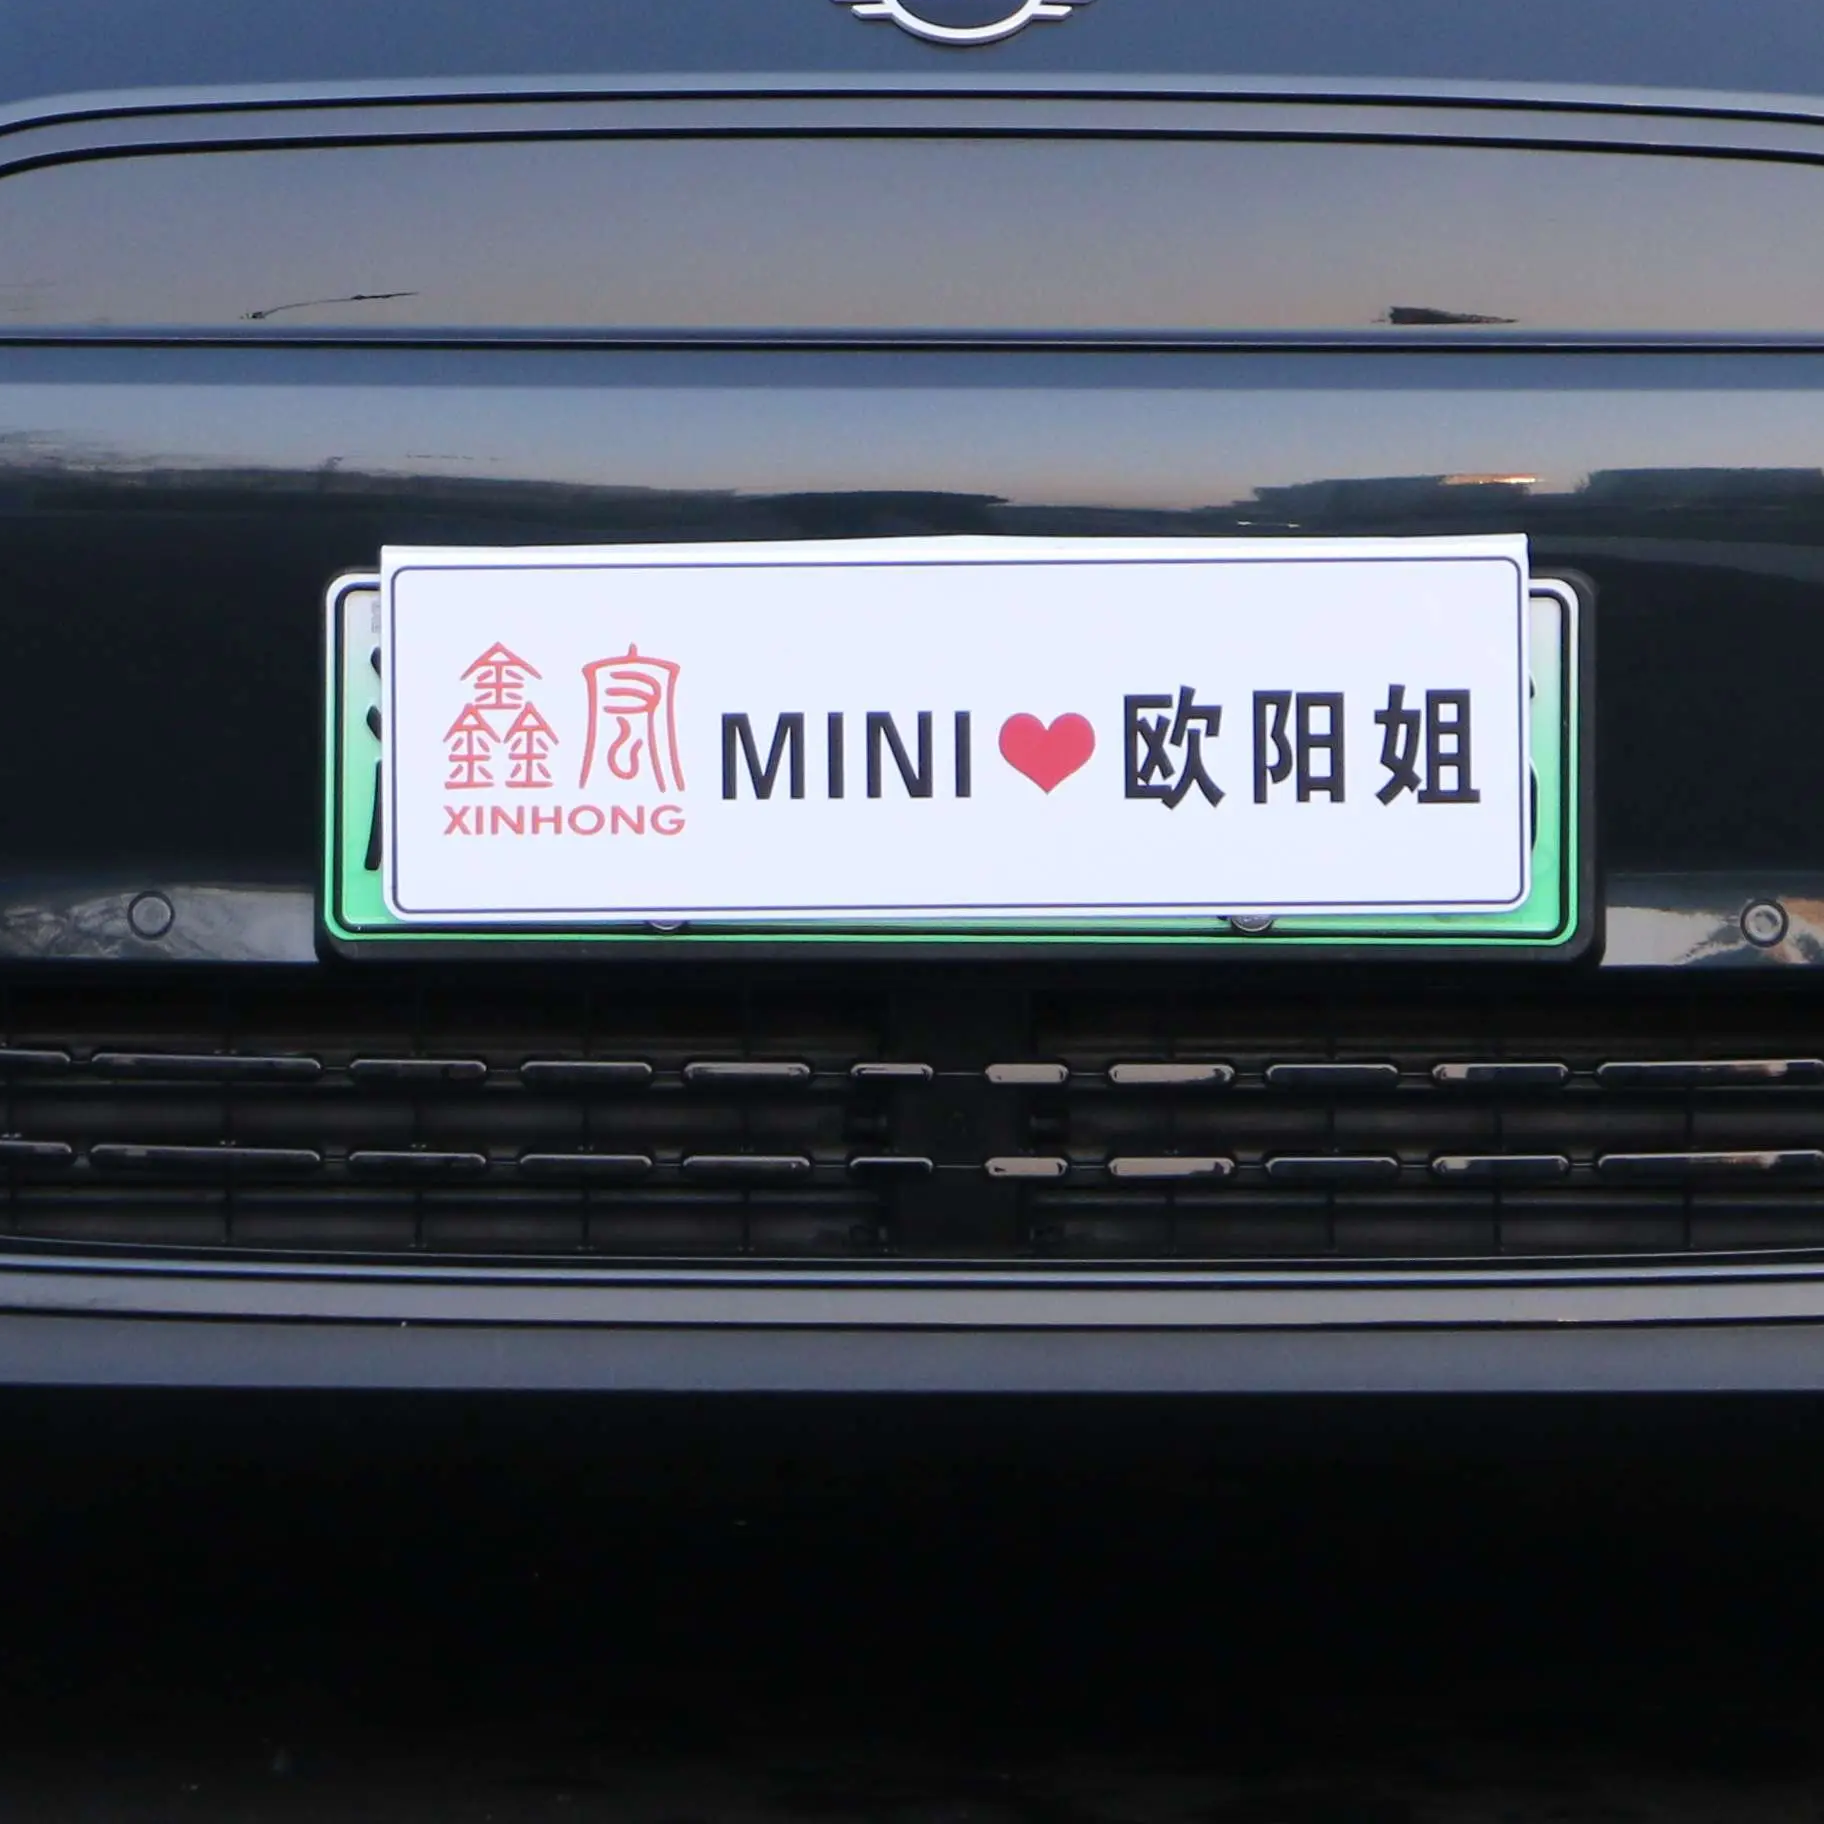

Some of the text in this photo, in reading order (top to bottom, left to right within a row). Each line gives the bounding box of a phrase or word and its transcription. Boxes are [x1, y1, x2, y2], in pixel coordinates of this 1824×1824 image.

[721, 710, 972, 800] MINI
[1123, 683, 1482, 811] 欧阳姐
[442, 804, 686, 836] XINHONG
